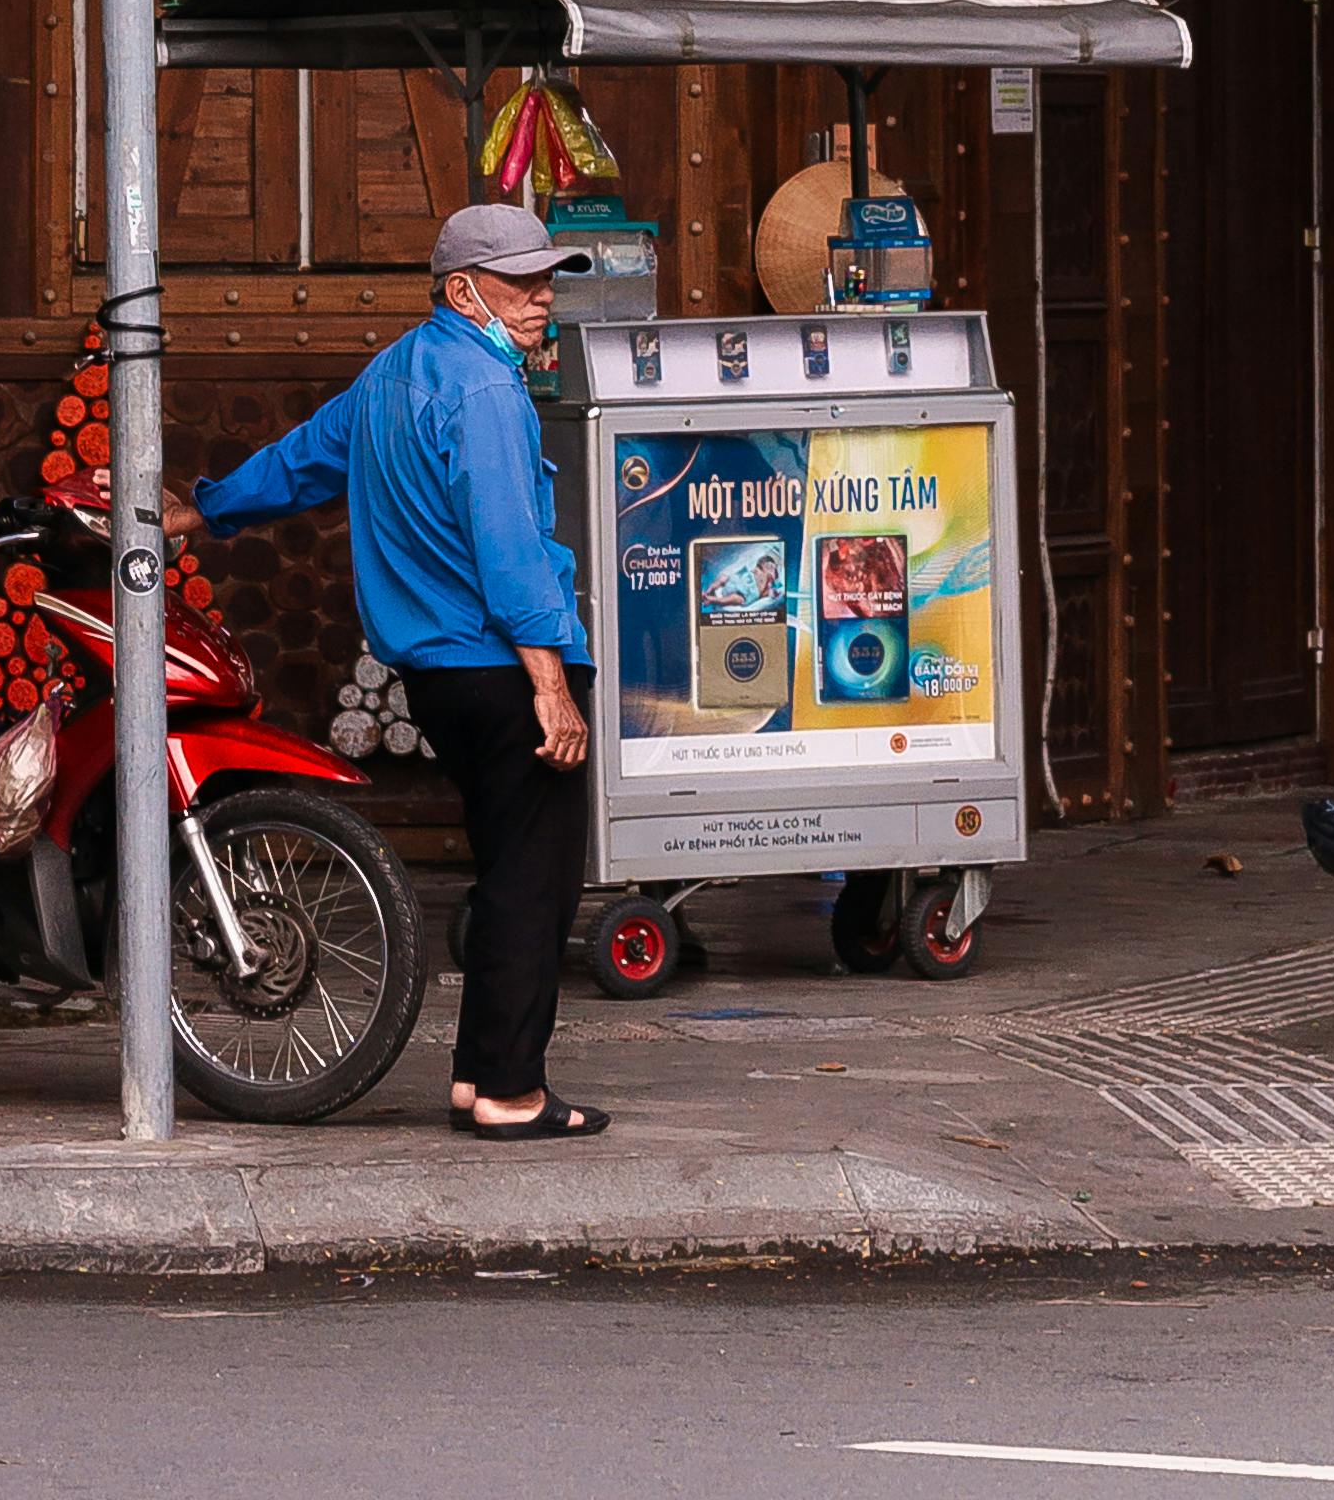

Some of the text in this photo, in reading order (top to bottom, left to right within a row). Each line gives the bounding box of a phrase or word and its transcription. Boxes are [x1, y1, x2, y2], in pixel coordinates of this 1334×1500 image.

[688, 465, 938, 525] MỘT BƯỚC XỨNG TẦM
[630, 570, 668, 591] 17.000
[924, 678, 962, 697] 18.000
[703, 820, 724, 833] HÚT
[727, 817, 764, 832] THUỐC
[767, 817, 780, 830] LÁ
[782, 816, 799, 829] CÓ
[663, 838, 686, 852] GÂY
[688, 837, 716, 852] BỆNH
